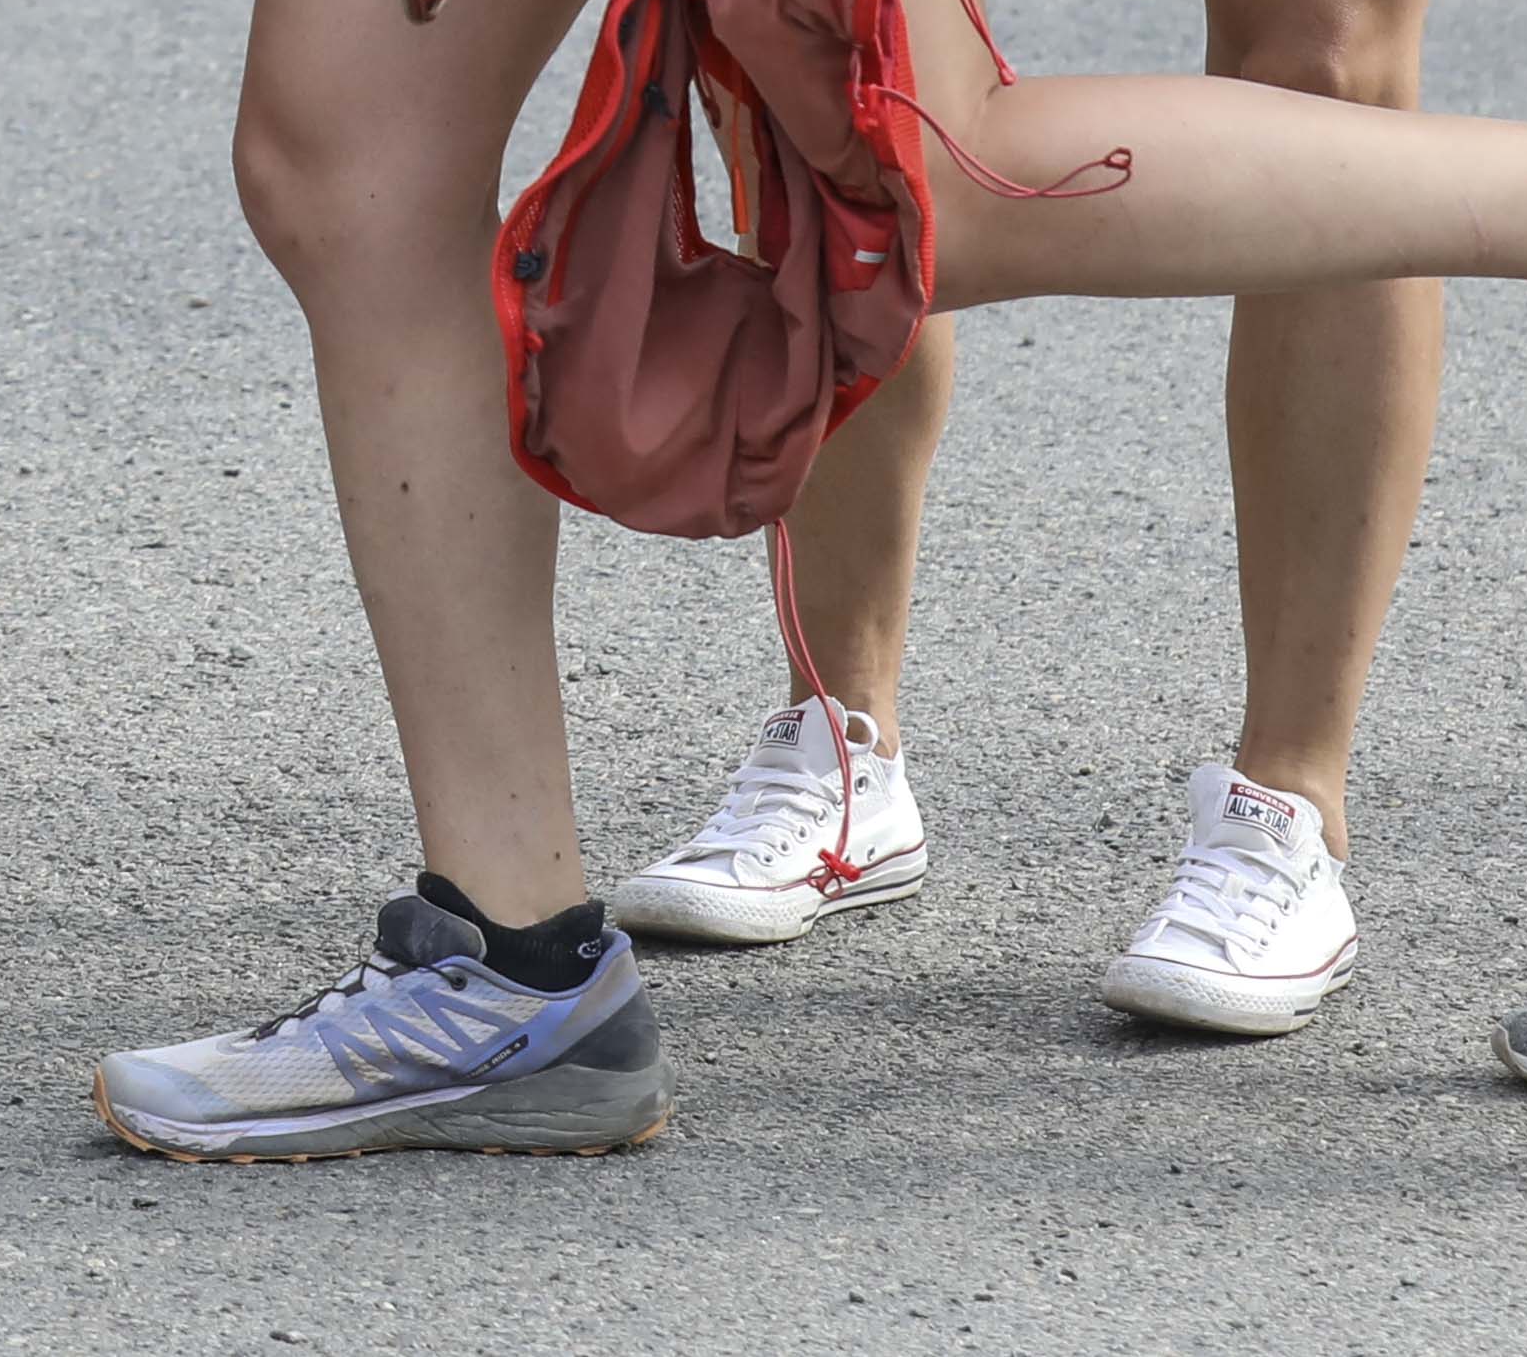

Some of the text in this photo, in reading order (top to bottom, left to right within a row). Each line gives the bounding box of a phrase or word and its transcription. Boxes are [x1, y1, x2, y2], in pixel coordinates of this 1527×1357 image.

[1228, 797, 1289, 835] ALL STAR
[1237, 786, 1290, 814] CONVERSE
